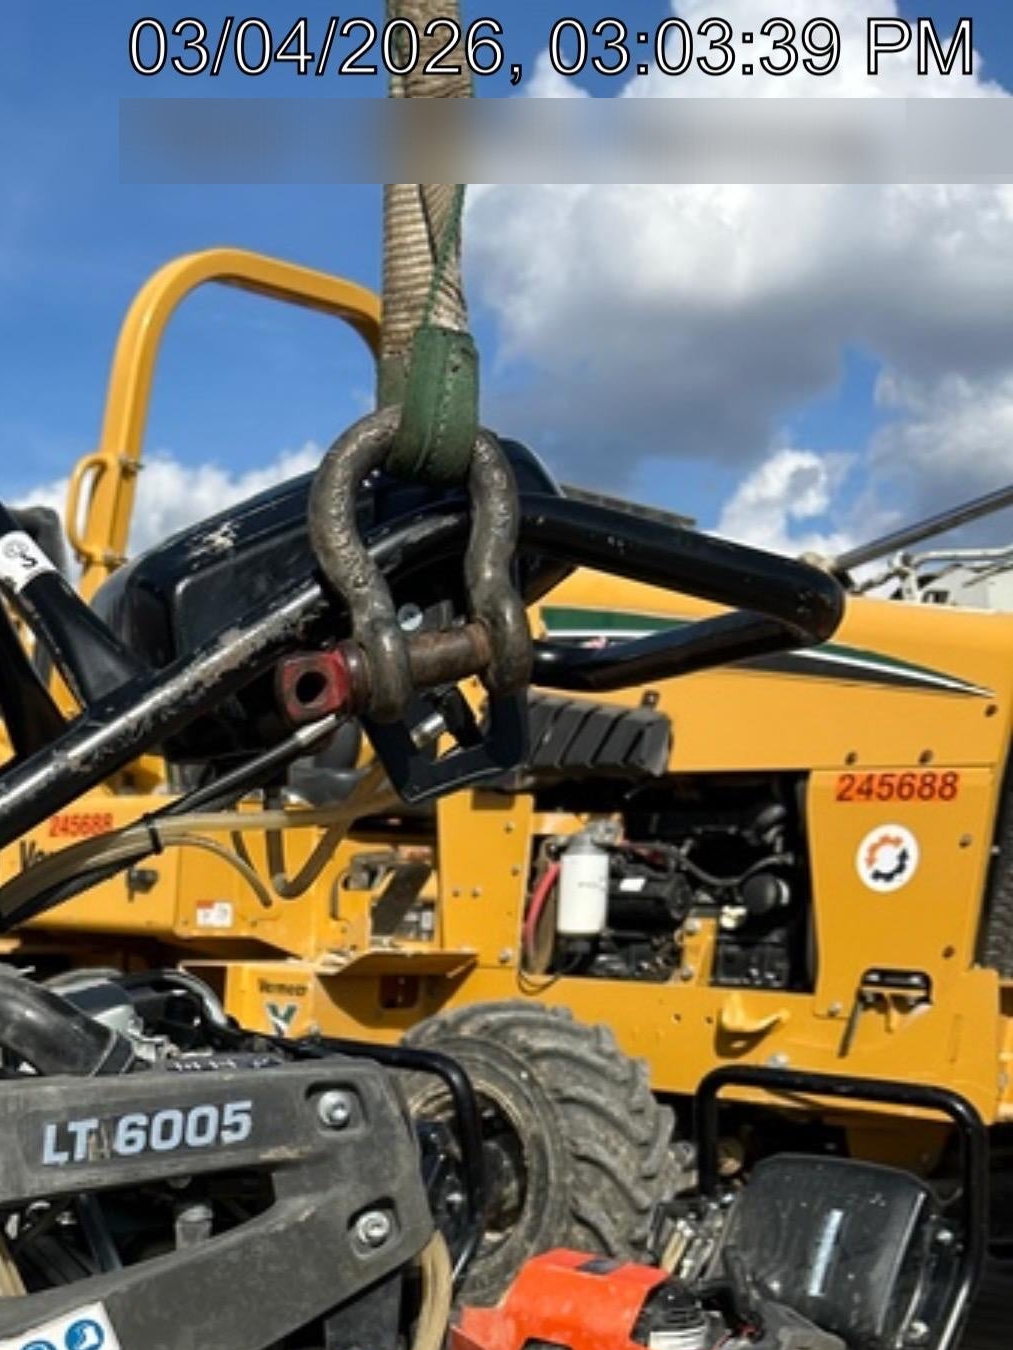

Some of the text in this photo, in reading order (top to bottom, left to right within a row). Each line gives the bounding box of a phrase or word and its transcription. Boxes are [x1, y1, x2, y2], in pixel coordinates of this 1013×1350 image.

[835, 770, 959, 802] 245688
[41, 1100, 253, 1166] LT 6005
